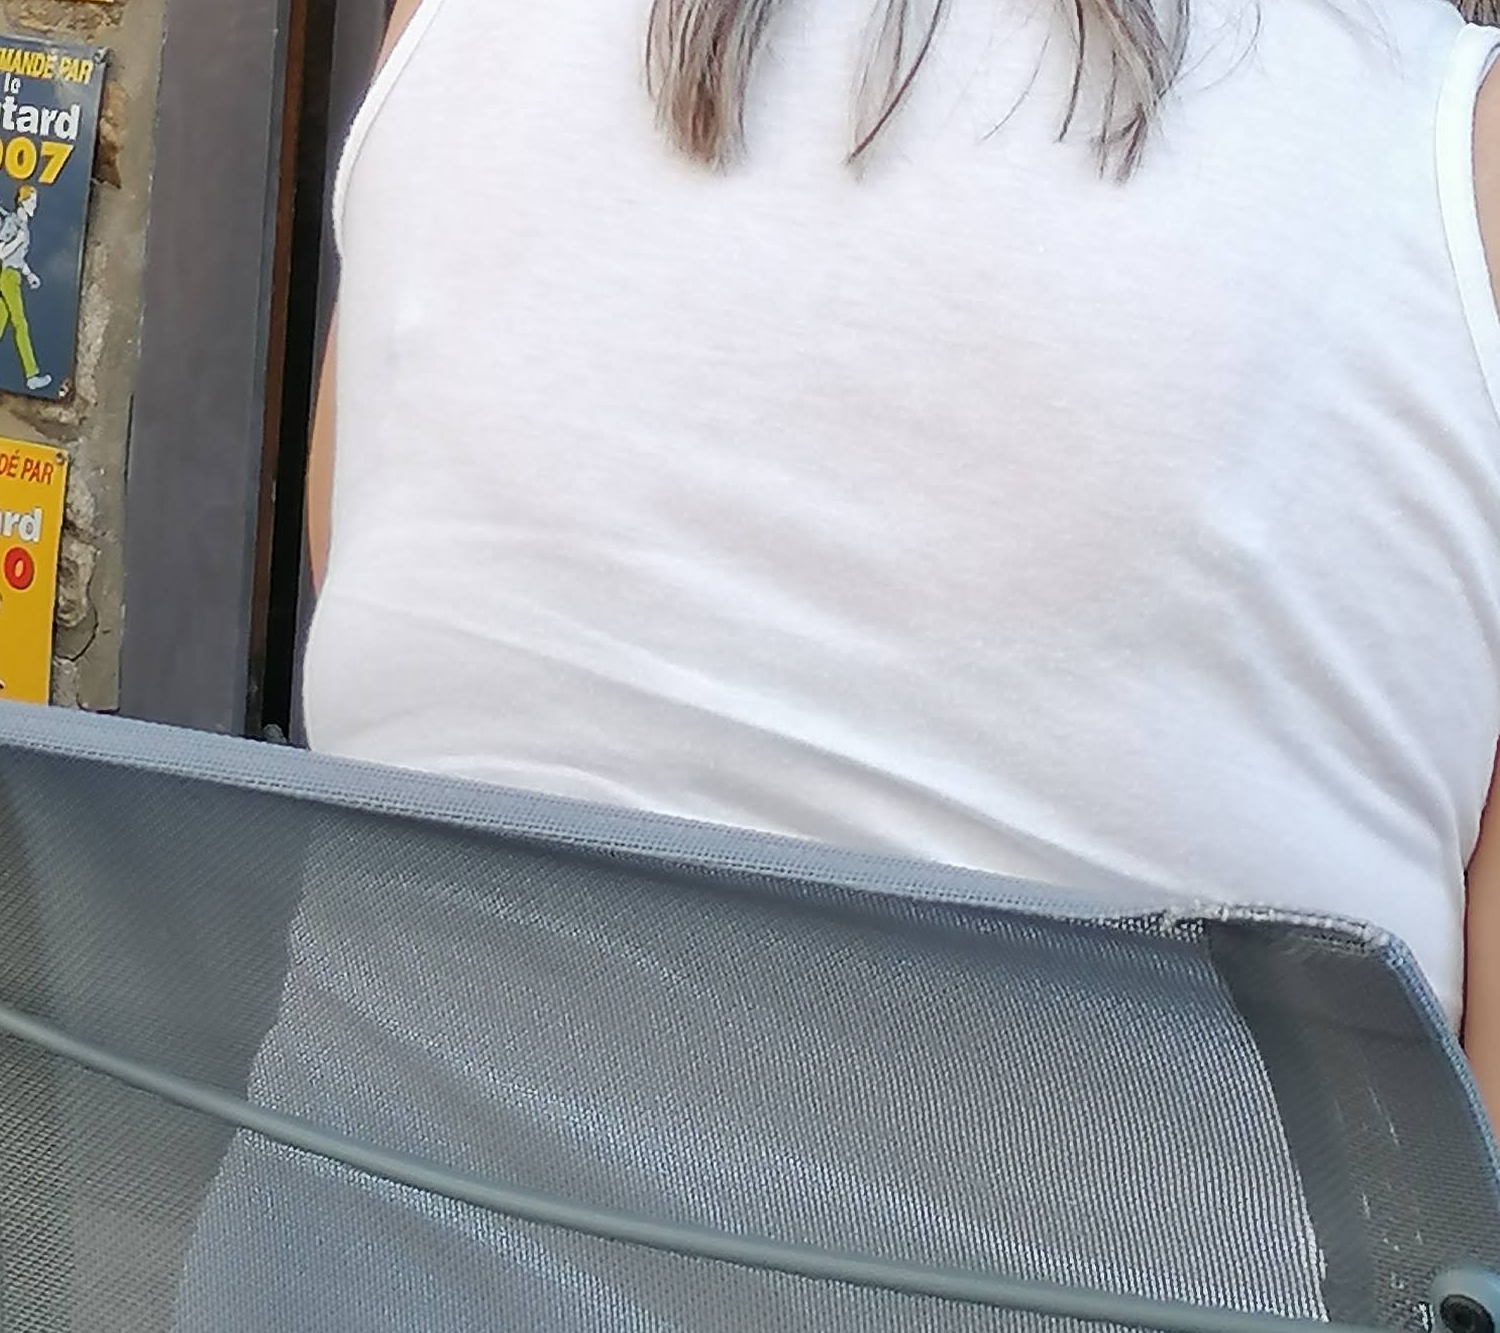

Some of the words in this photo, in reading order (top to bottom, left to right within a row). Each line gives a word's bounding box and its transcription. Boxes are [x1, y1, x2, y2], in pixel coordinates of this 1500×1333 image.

[3, 72, 22, 94] le
[58, 55, 94, 86] PAR
[20, 456, 55, 486] PAR
